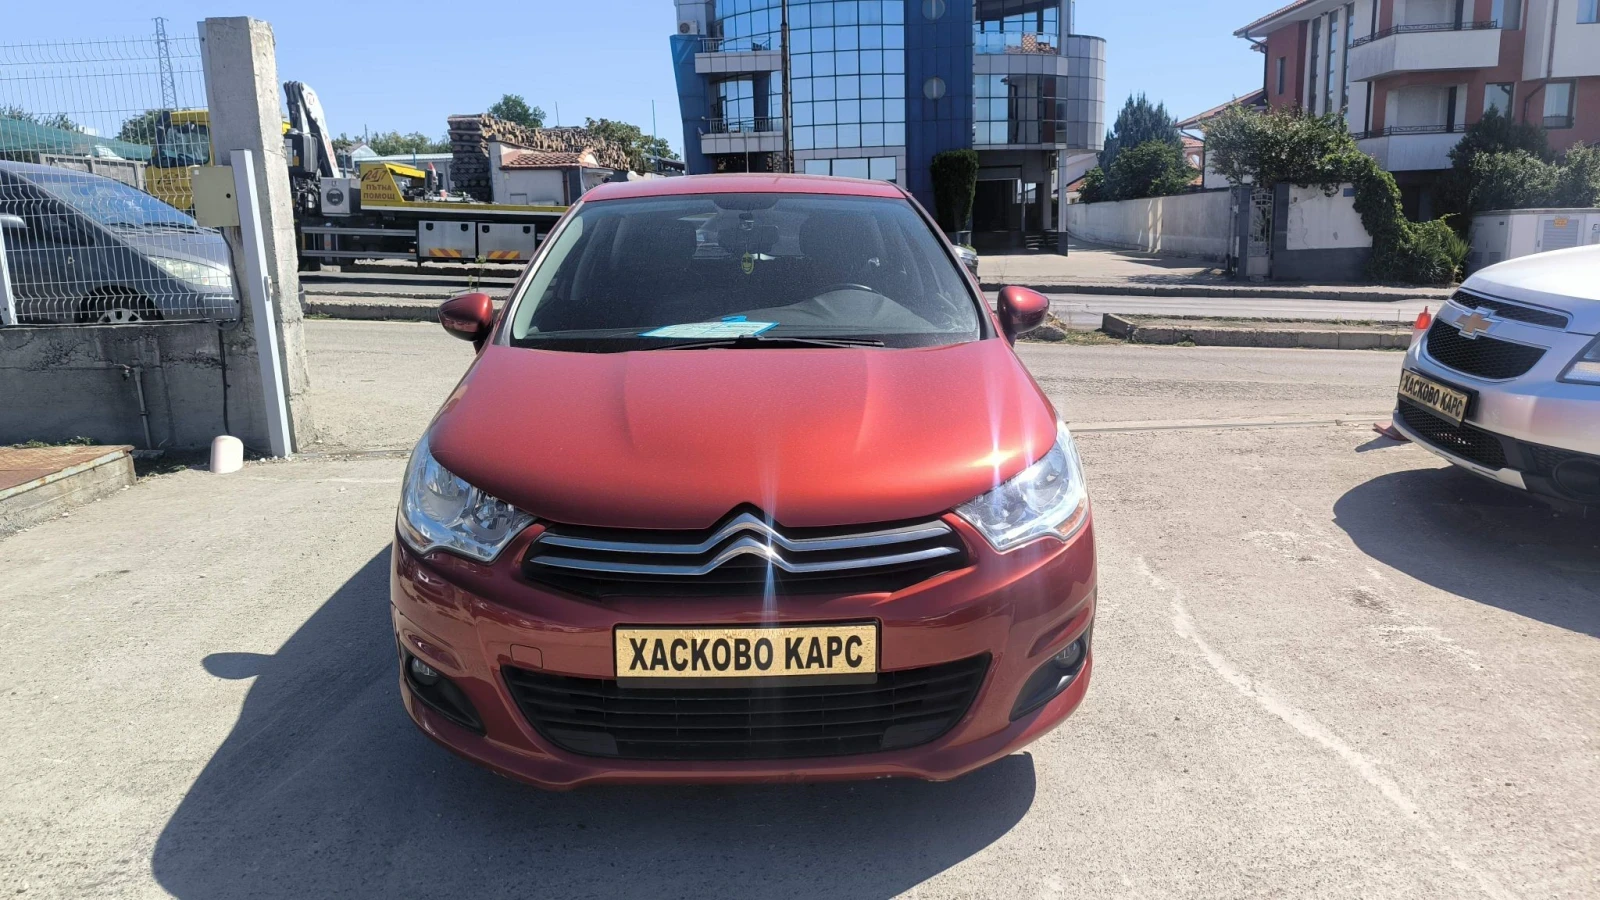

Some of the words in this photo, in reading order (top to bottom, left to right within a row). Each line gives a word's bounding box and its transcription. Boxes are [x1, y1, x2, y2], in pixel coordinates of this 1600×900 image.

[363, 192, 396, 200] ПОМОЩ
[1403, 375, 1440, 406] ХАСКОВО
[1440, 391, 1463, 417] КАРС
[629, 637, 774, 671] ХАСКОВО
[785, 635, 863, 669] КАРС
